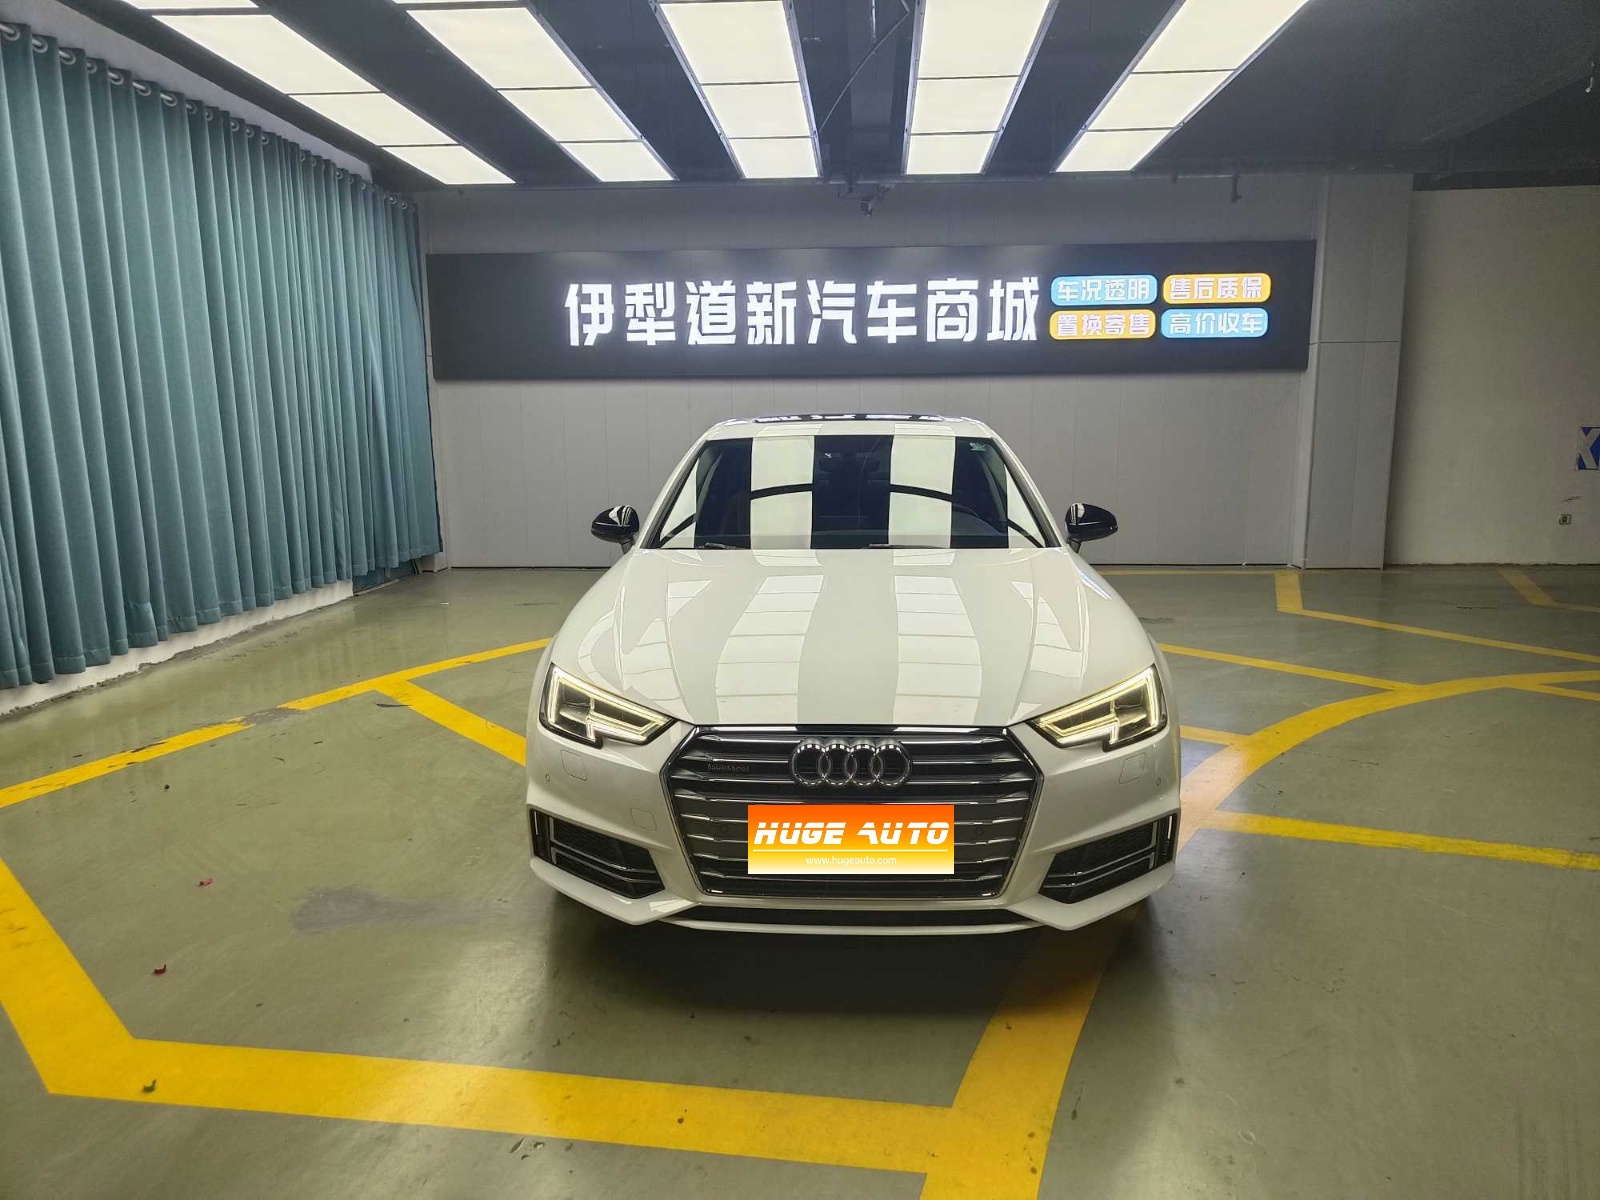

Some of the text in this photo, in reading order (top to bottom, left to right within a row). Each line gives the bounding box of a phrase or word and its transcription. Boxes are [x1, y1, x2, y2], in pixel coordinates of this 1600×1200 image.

[1057, 278, 1150, 301] 车况透明
[1169, 276, 1263, 300] 售后质保
[565, 277, 1039, 346] 伊犁道新汽车商城
[1169, 312, 1263, 335] 高价收车
[1056, 313, 1150, 337] 置换寄售
